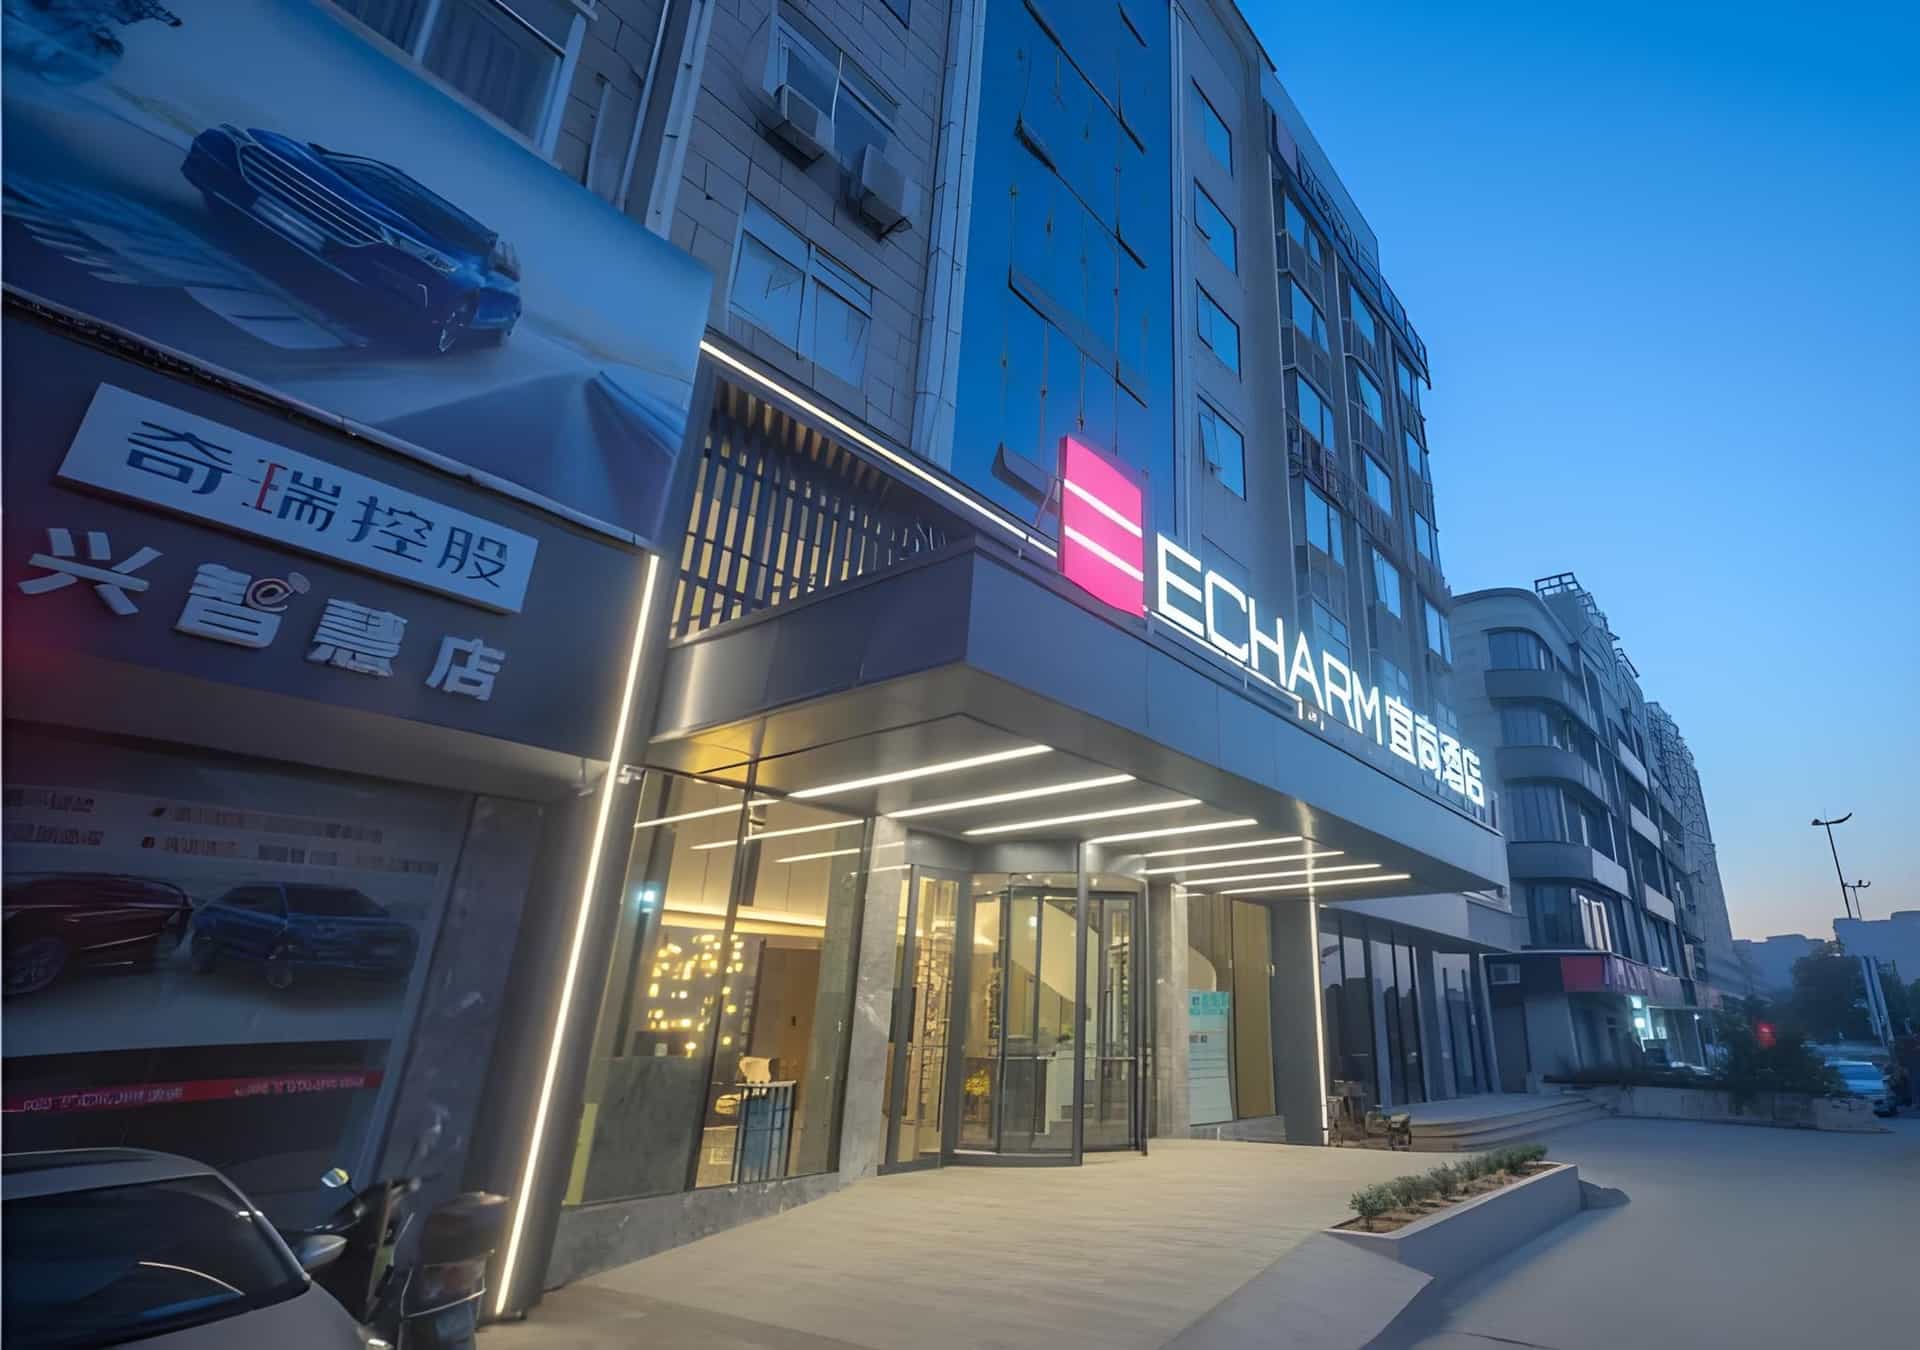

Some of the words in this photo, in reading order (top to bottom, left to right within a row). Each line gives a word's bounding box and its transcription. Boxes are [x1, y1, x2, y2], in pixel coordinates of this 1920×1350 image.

[122, 420, 509, 589] 奇瑞控股
[1157, 533, 1383, 746] ECHARM
[1385, 695, 1486, 808] 宜尚酒店
